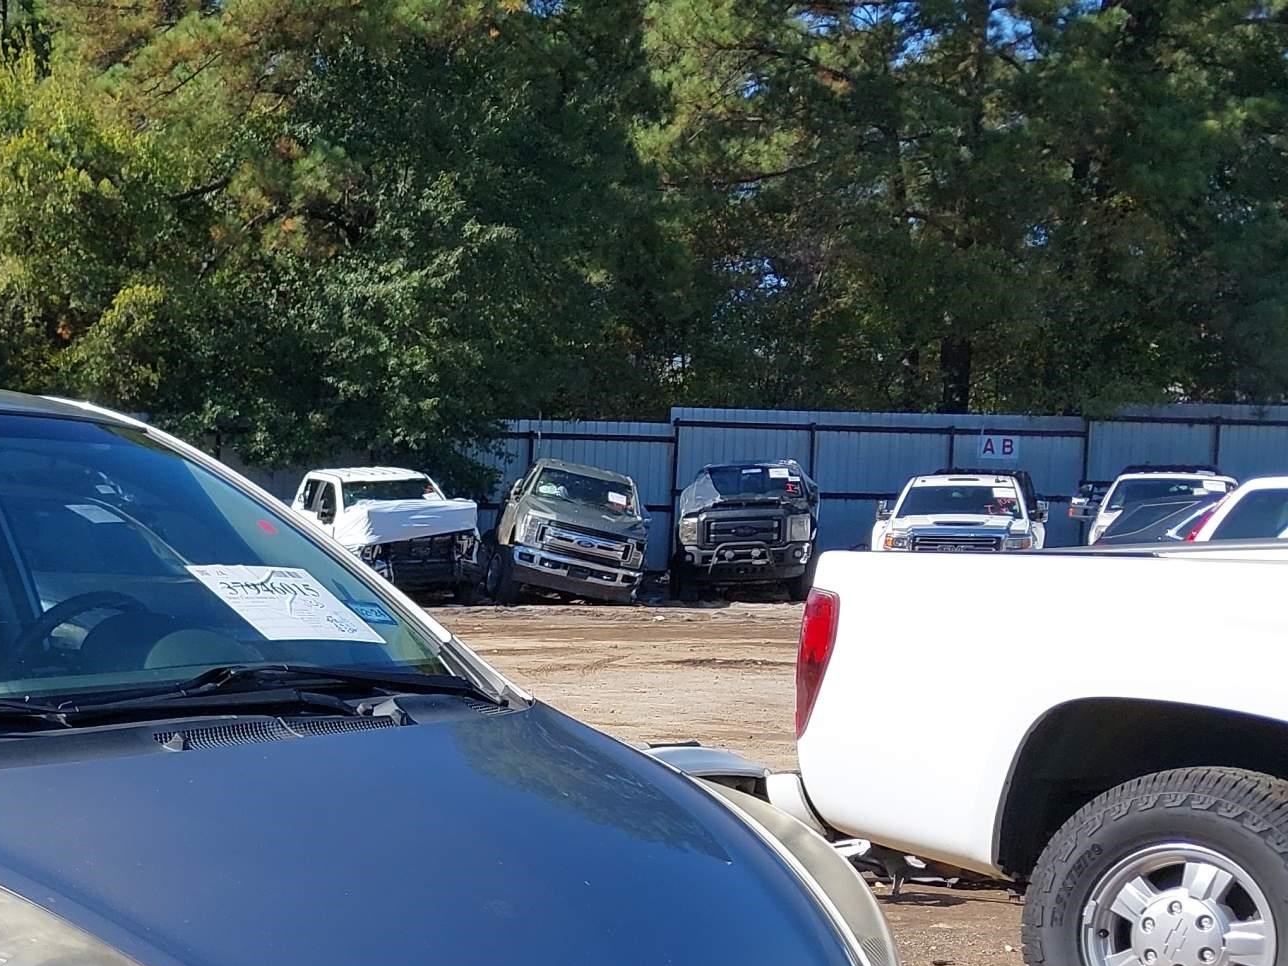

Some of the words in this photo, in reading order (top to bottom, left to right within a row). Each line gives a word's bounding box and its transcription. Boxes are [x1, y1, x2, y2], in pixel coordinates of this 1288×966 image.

[982, 438, 995, 455] A
[1002, 438, 1014, 455] B
[219, 581, 320, 598] 37946015
